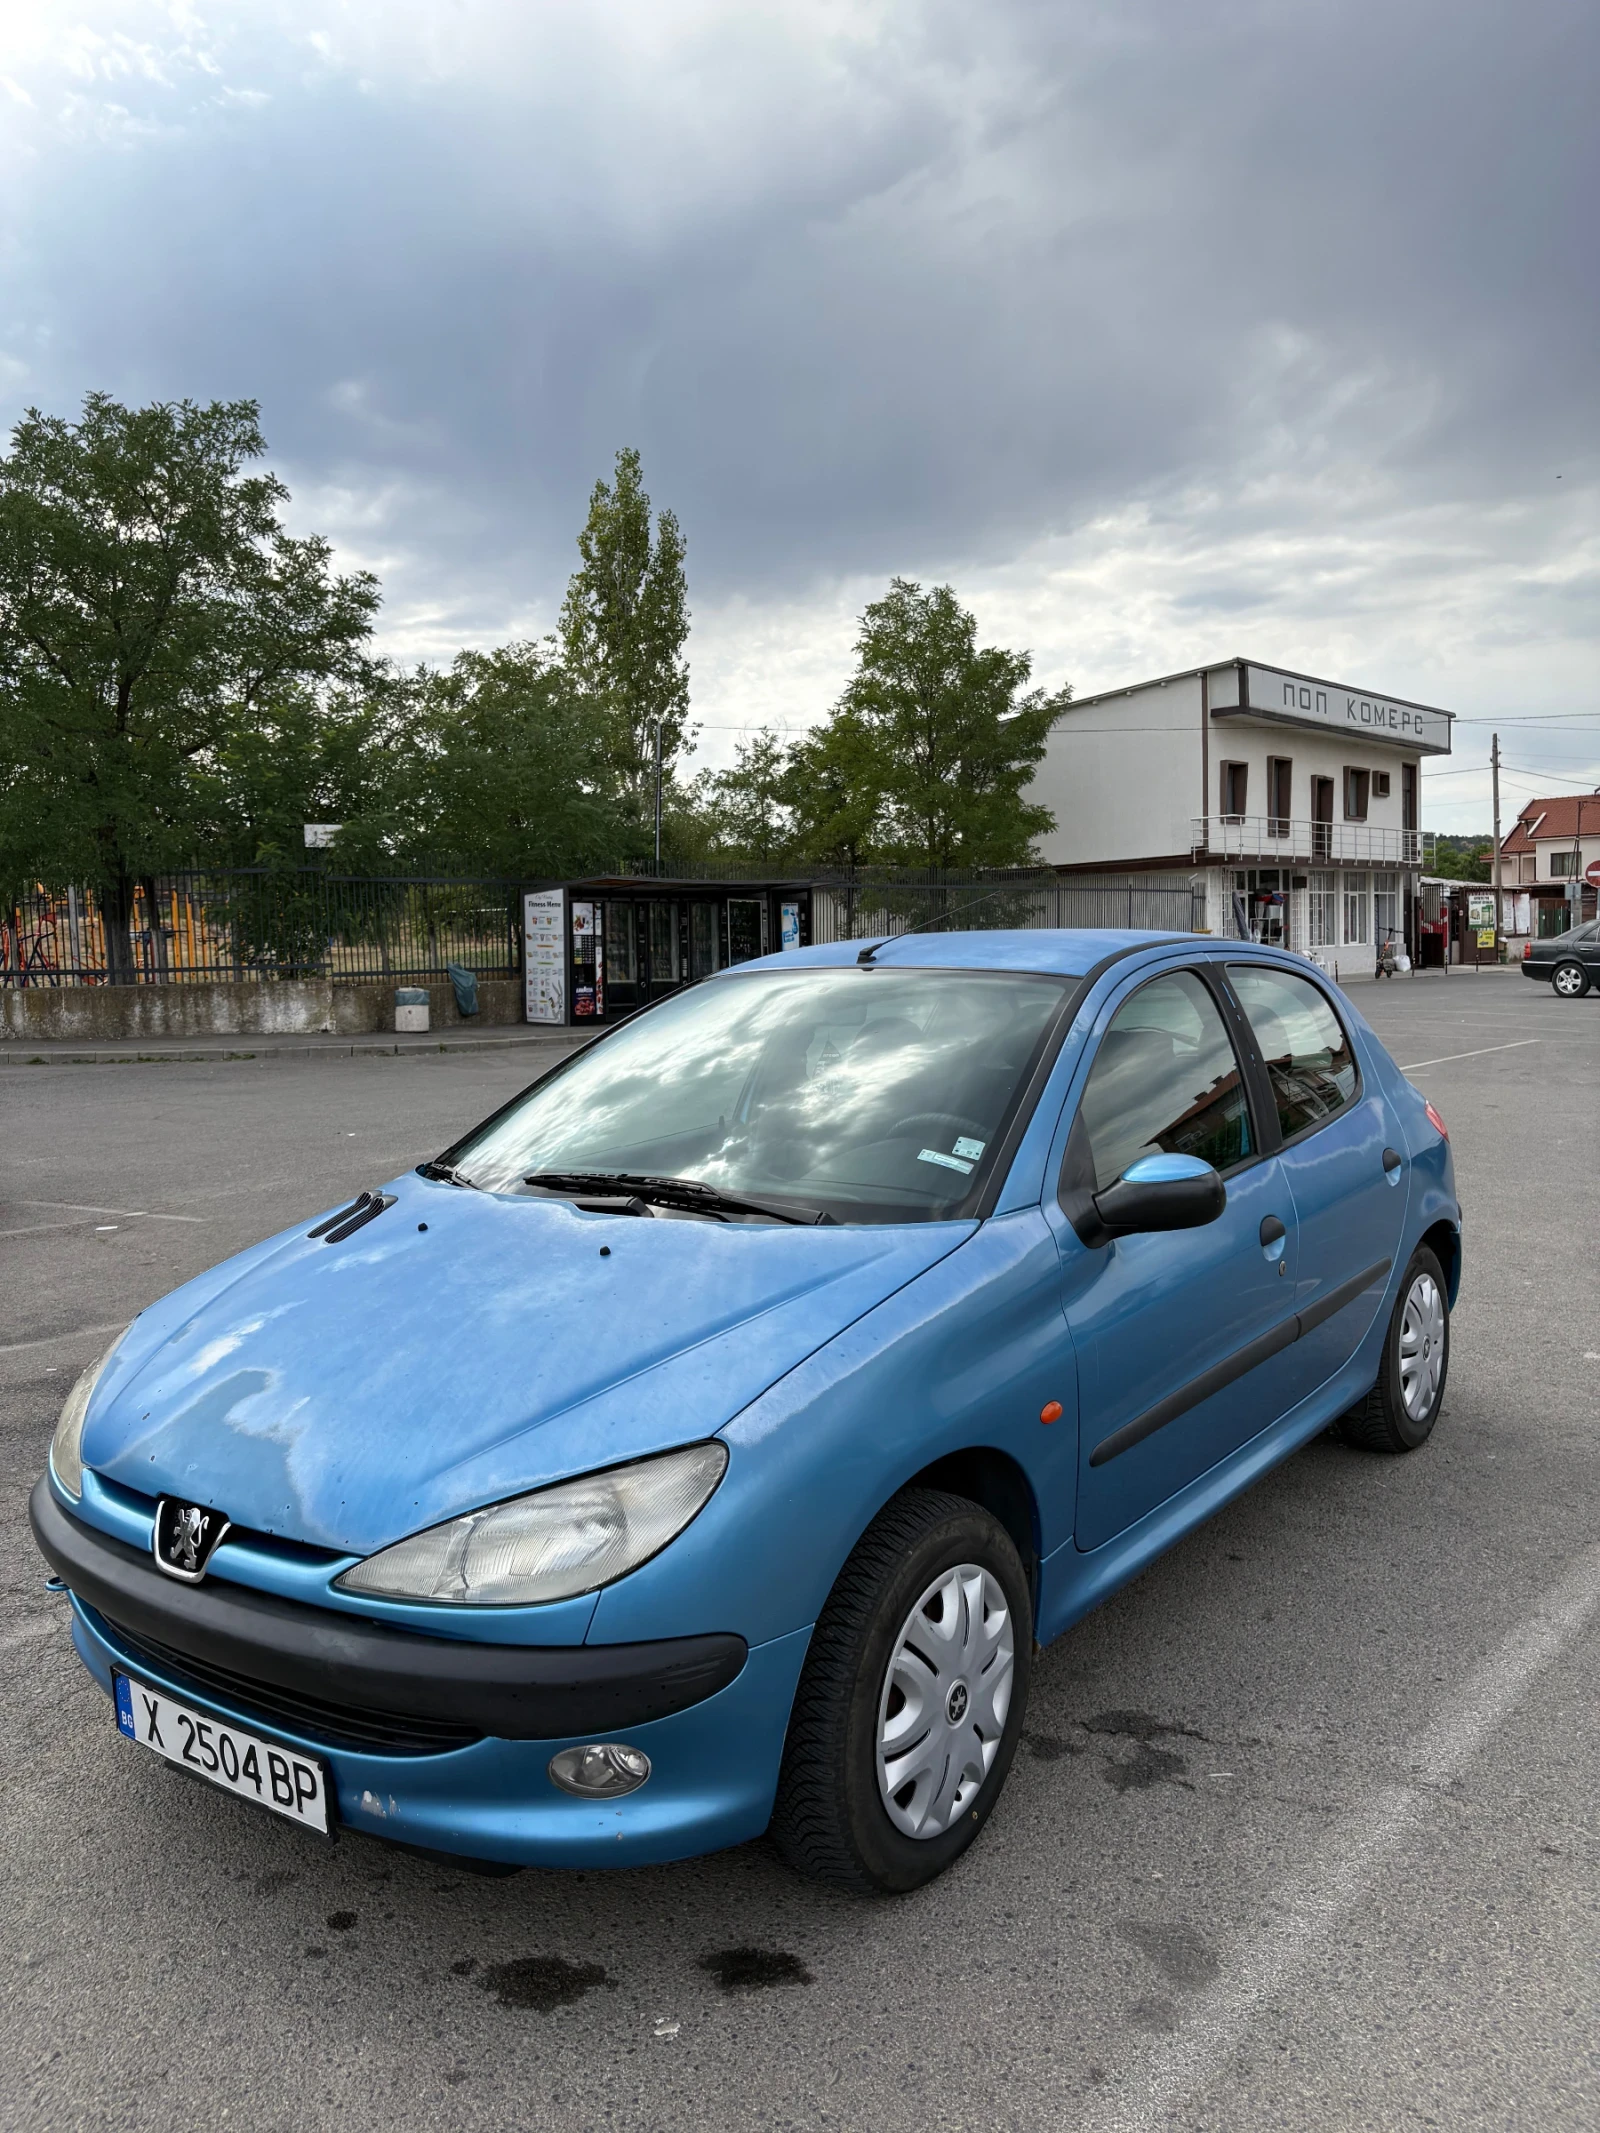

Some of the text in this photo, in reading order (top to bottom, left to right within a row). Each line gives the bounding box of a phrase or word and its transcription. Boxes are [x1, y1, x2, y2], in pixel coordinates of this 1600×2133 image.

[1283, 683, 1423, 735] ПОП КОМЕРС
[121, 1710, 134, 1728] BG
[177, 1713, 263, 1795] 2504
[267, 1750, 318, 1814] BP
